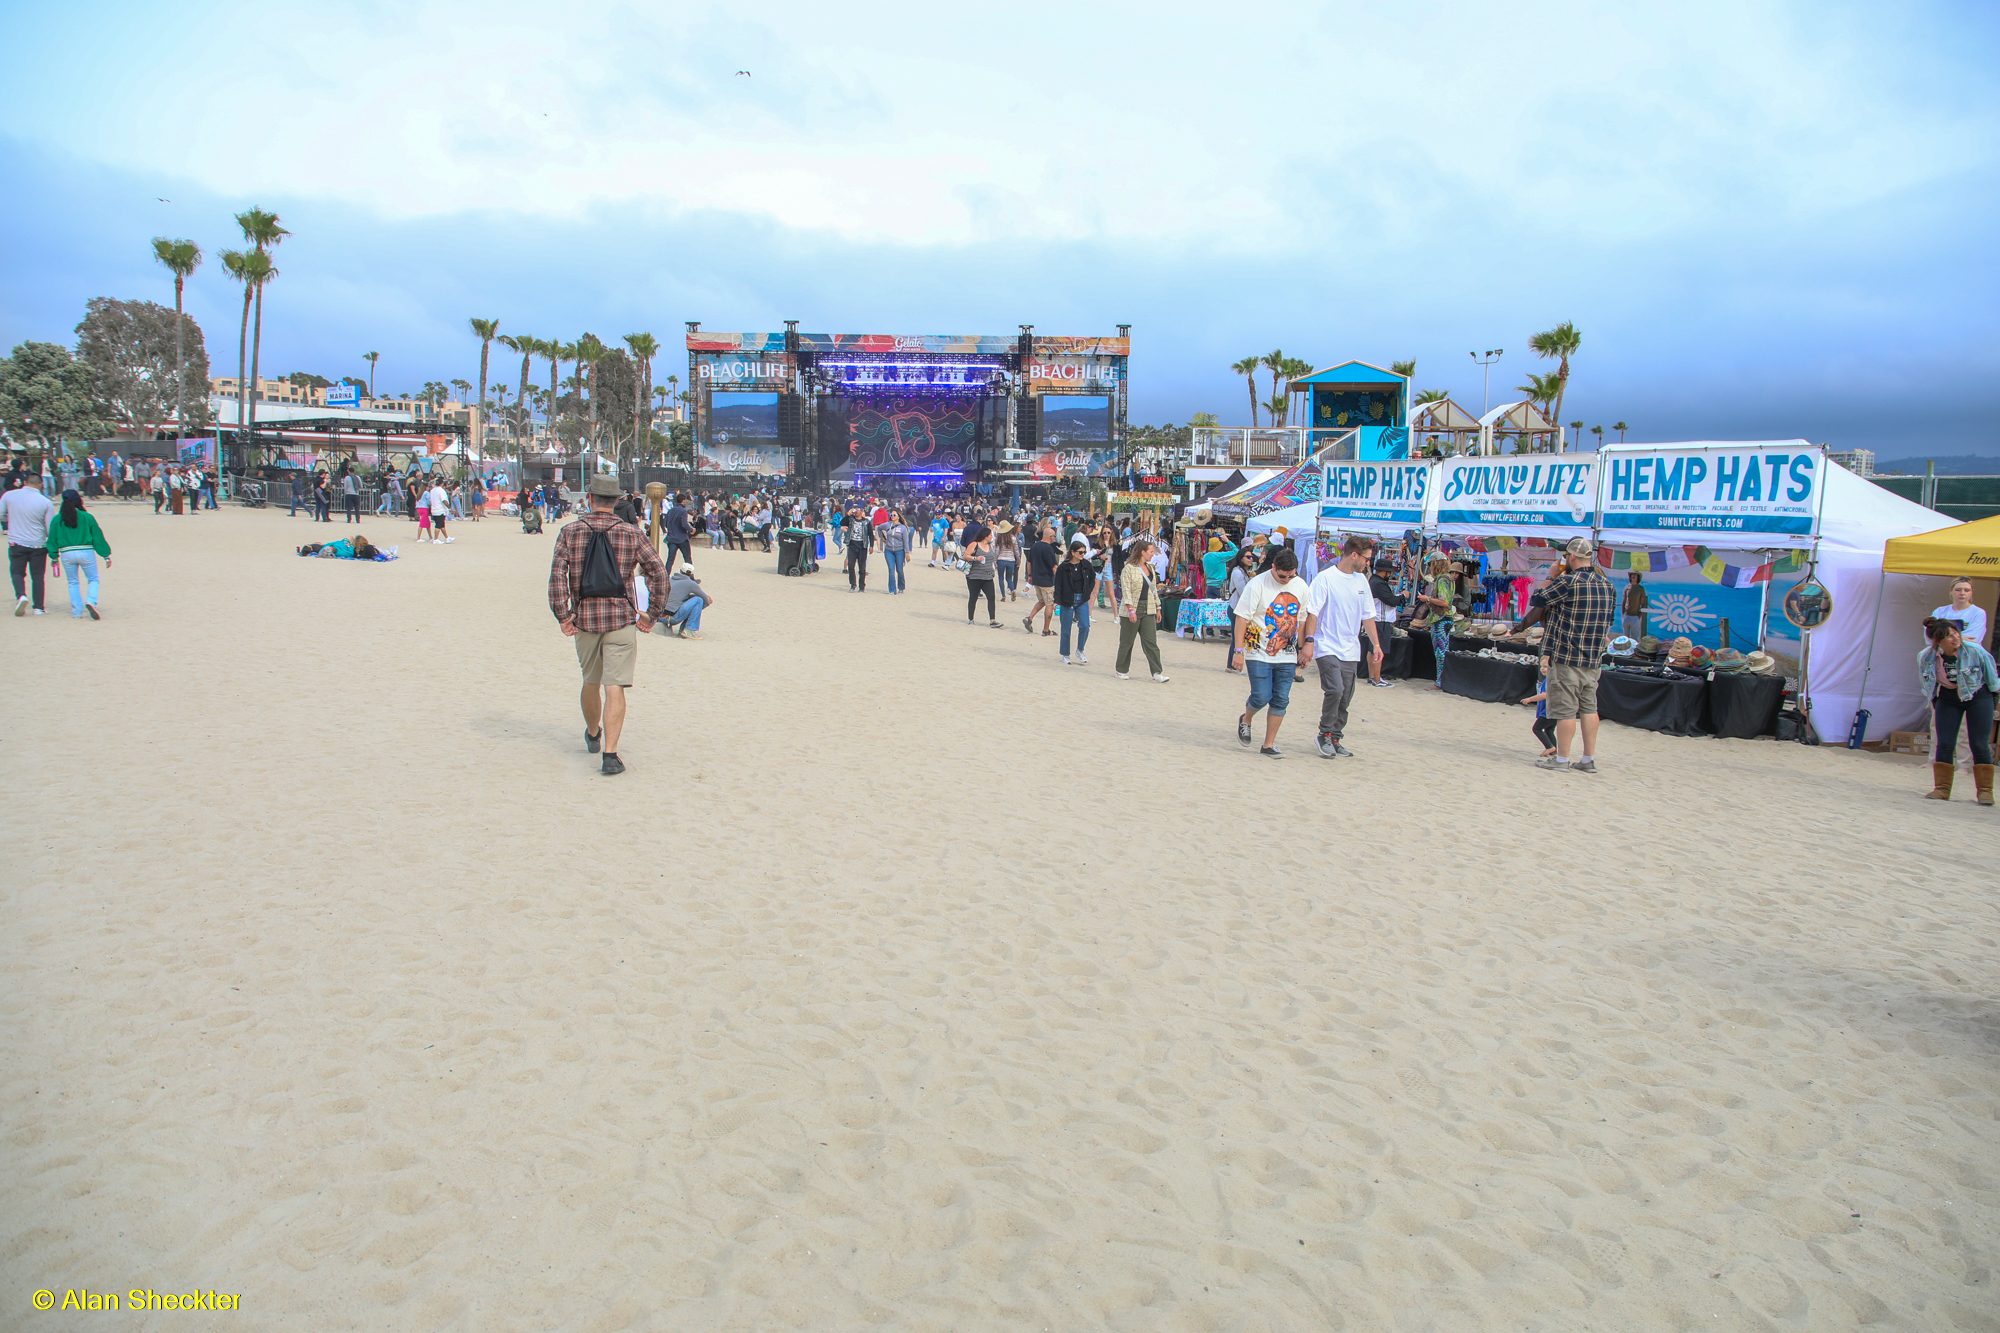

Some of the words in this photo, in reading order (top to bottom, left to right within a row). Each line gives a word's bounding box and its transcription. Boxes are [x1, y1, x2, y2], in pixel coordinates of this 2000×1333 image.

[895, 336, 922, 352] Gelato
[700, 362, 788, 378] BEACHLIFE
[1030, 364, 1119, 380] BEACHLIFE
[330, 392, 353, 400] MARINA
[728, 450, 763, 470] Gelato
[1055, 451, 1090, 471] Gelato
[1143, 476, 1165, 484] DAOU
[1326, 467, 1377, 499] HEMP
[1380, 467, 1427, 500] HATS
[1444, 465, 1528, 501] SUNNY
[1528, 464, 1591, 495] LIFE
[1611, 457, 1707, 501] HEMP
[1714, 454, 1813, 502] HATS
[1349, 510, 1393, 519] SUNNYLIFEHATS.COM
[1480, 513, 1545, 523] SUNNYLIFEHATS.COM
[1658, 517, 1744, 528] SUNNYLIFEHATS.COM
[1967, 552, 1999, 565] From
